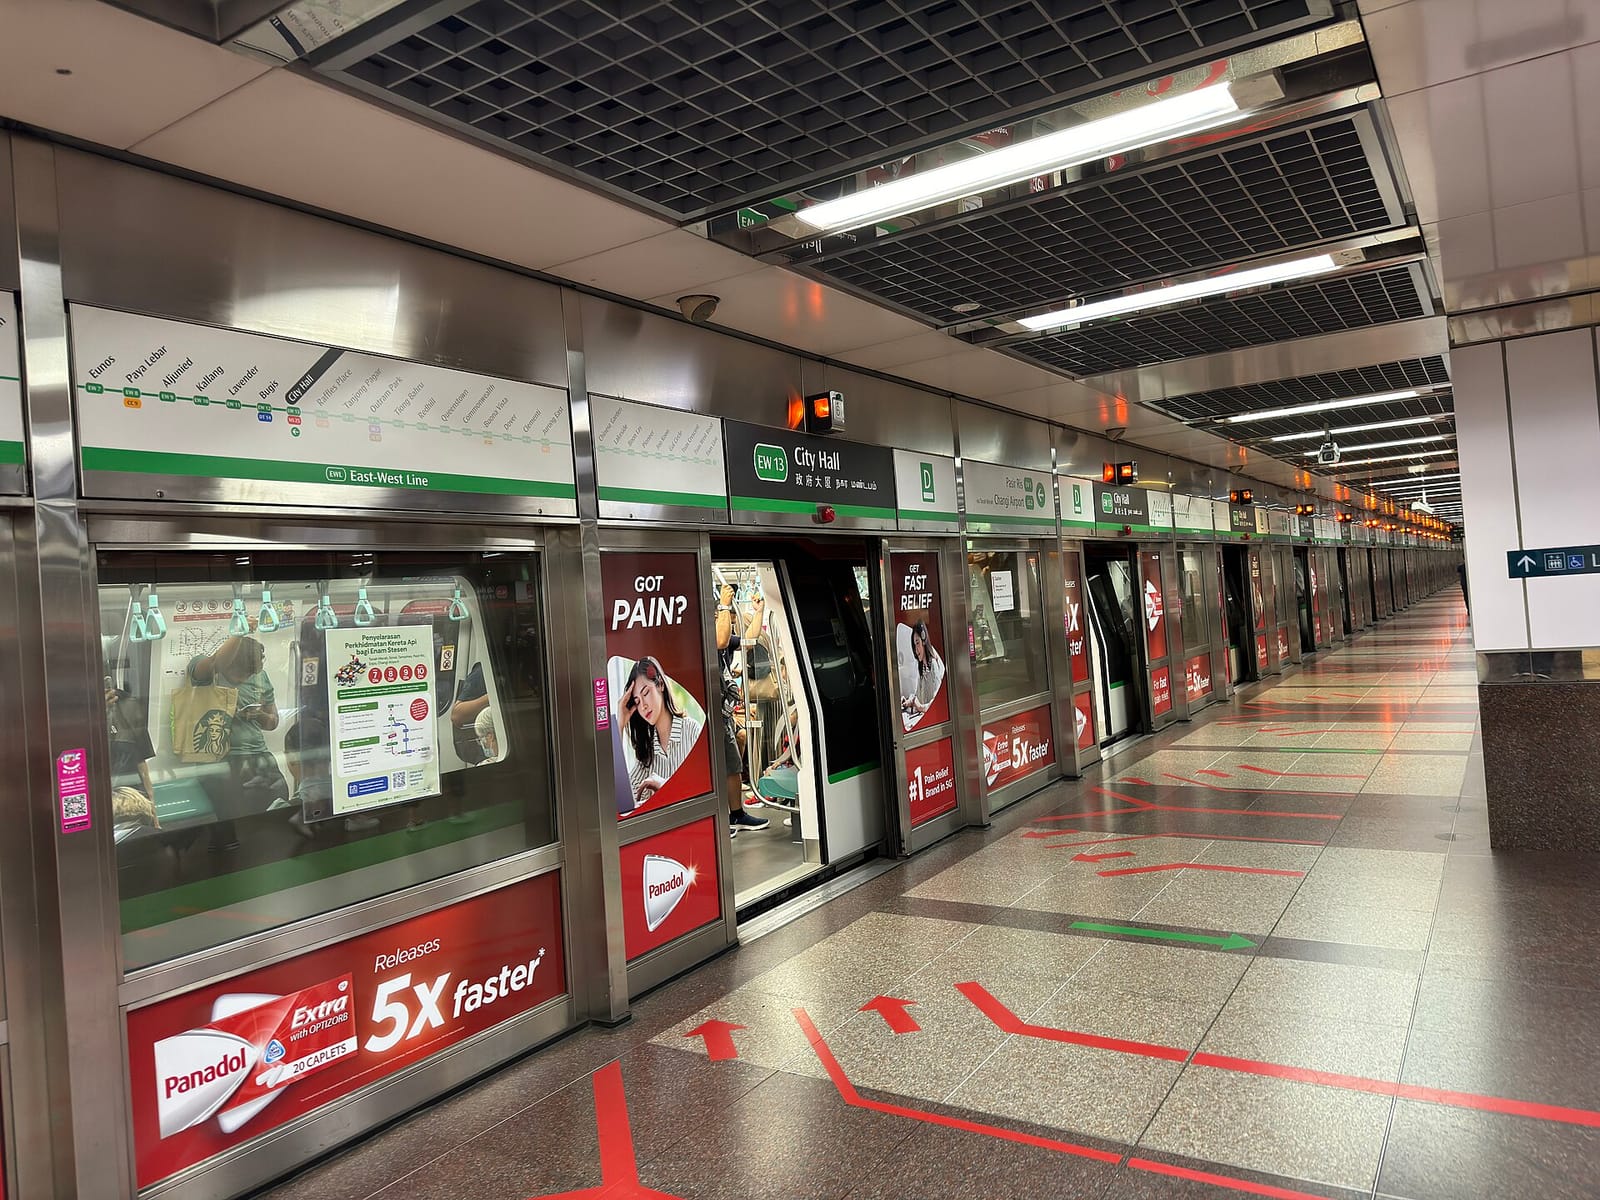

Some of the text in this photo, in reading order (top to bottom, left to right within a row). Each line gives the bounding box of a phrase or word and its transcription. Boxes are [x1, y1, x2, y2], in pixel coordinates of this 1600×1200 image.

[88, 354, 116, 379] Eunos
[125, 344, 168, 384] Paya Lebar
[162, 357, 194, 388] Aljunied
[195, 365, 225, 392] Kallang
[228, 364, 259, 396] Lavender
[258, 379, 279, 400] Bugis
[288, 374, 314, 403] City Hall
[316, 369, 353, 407] Raffles Place
[369, 376, 403, 413] Outram Park
[417, 396, 437, 419] Redhill
[757, 455, 785, 472] EW 13
[794, 447, 841, 472] City Hall
[329, 470, 429, 487] EWL East-West Line
[795, 473, 832, 489] 政府大厦
[923, 469, 931, 489] D
[909, 564, 920, 574] GET
[634, 575, 664, 593] GOT
[904, 574, 927, 592] FAST
[611, 595, 688, 631] PAIN?
[900, 593, 933, 611] RELIEF
[344, 641, 387, 649] Perkhidmatan
[407, 639, 417, 647] Api
[361, 634, 401, 642] Penyelarasan
[908, 765, 924, 803] #1
[924, 766, 949, 785] Pain Relief
[925, 783, 940, 799] Brand
[940, 782, 946, 792] in
[649, 872, 684, 899] Panadol
[374, 938, 441, 974] Releases
[290, 995, 349, 1031] Extra
[290, 1012, 349, 1042] with OPTIZORB
[293, 1045, 347, 1074] 20 CAPLETS
[165, 1048, 247, 1099] Panadol
